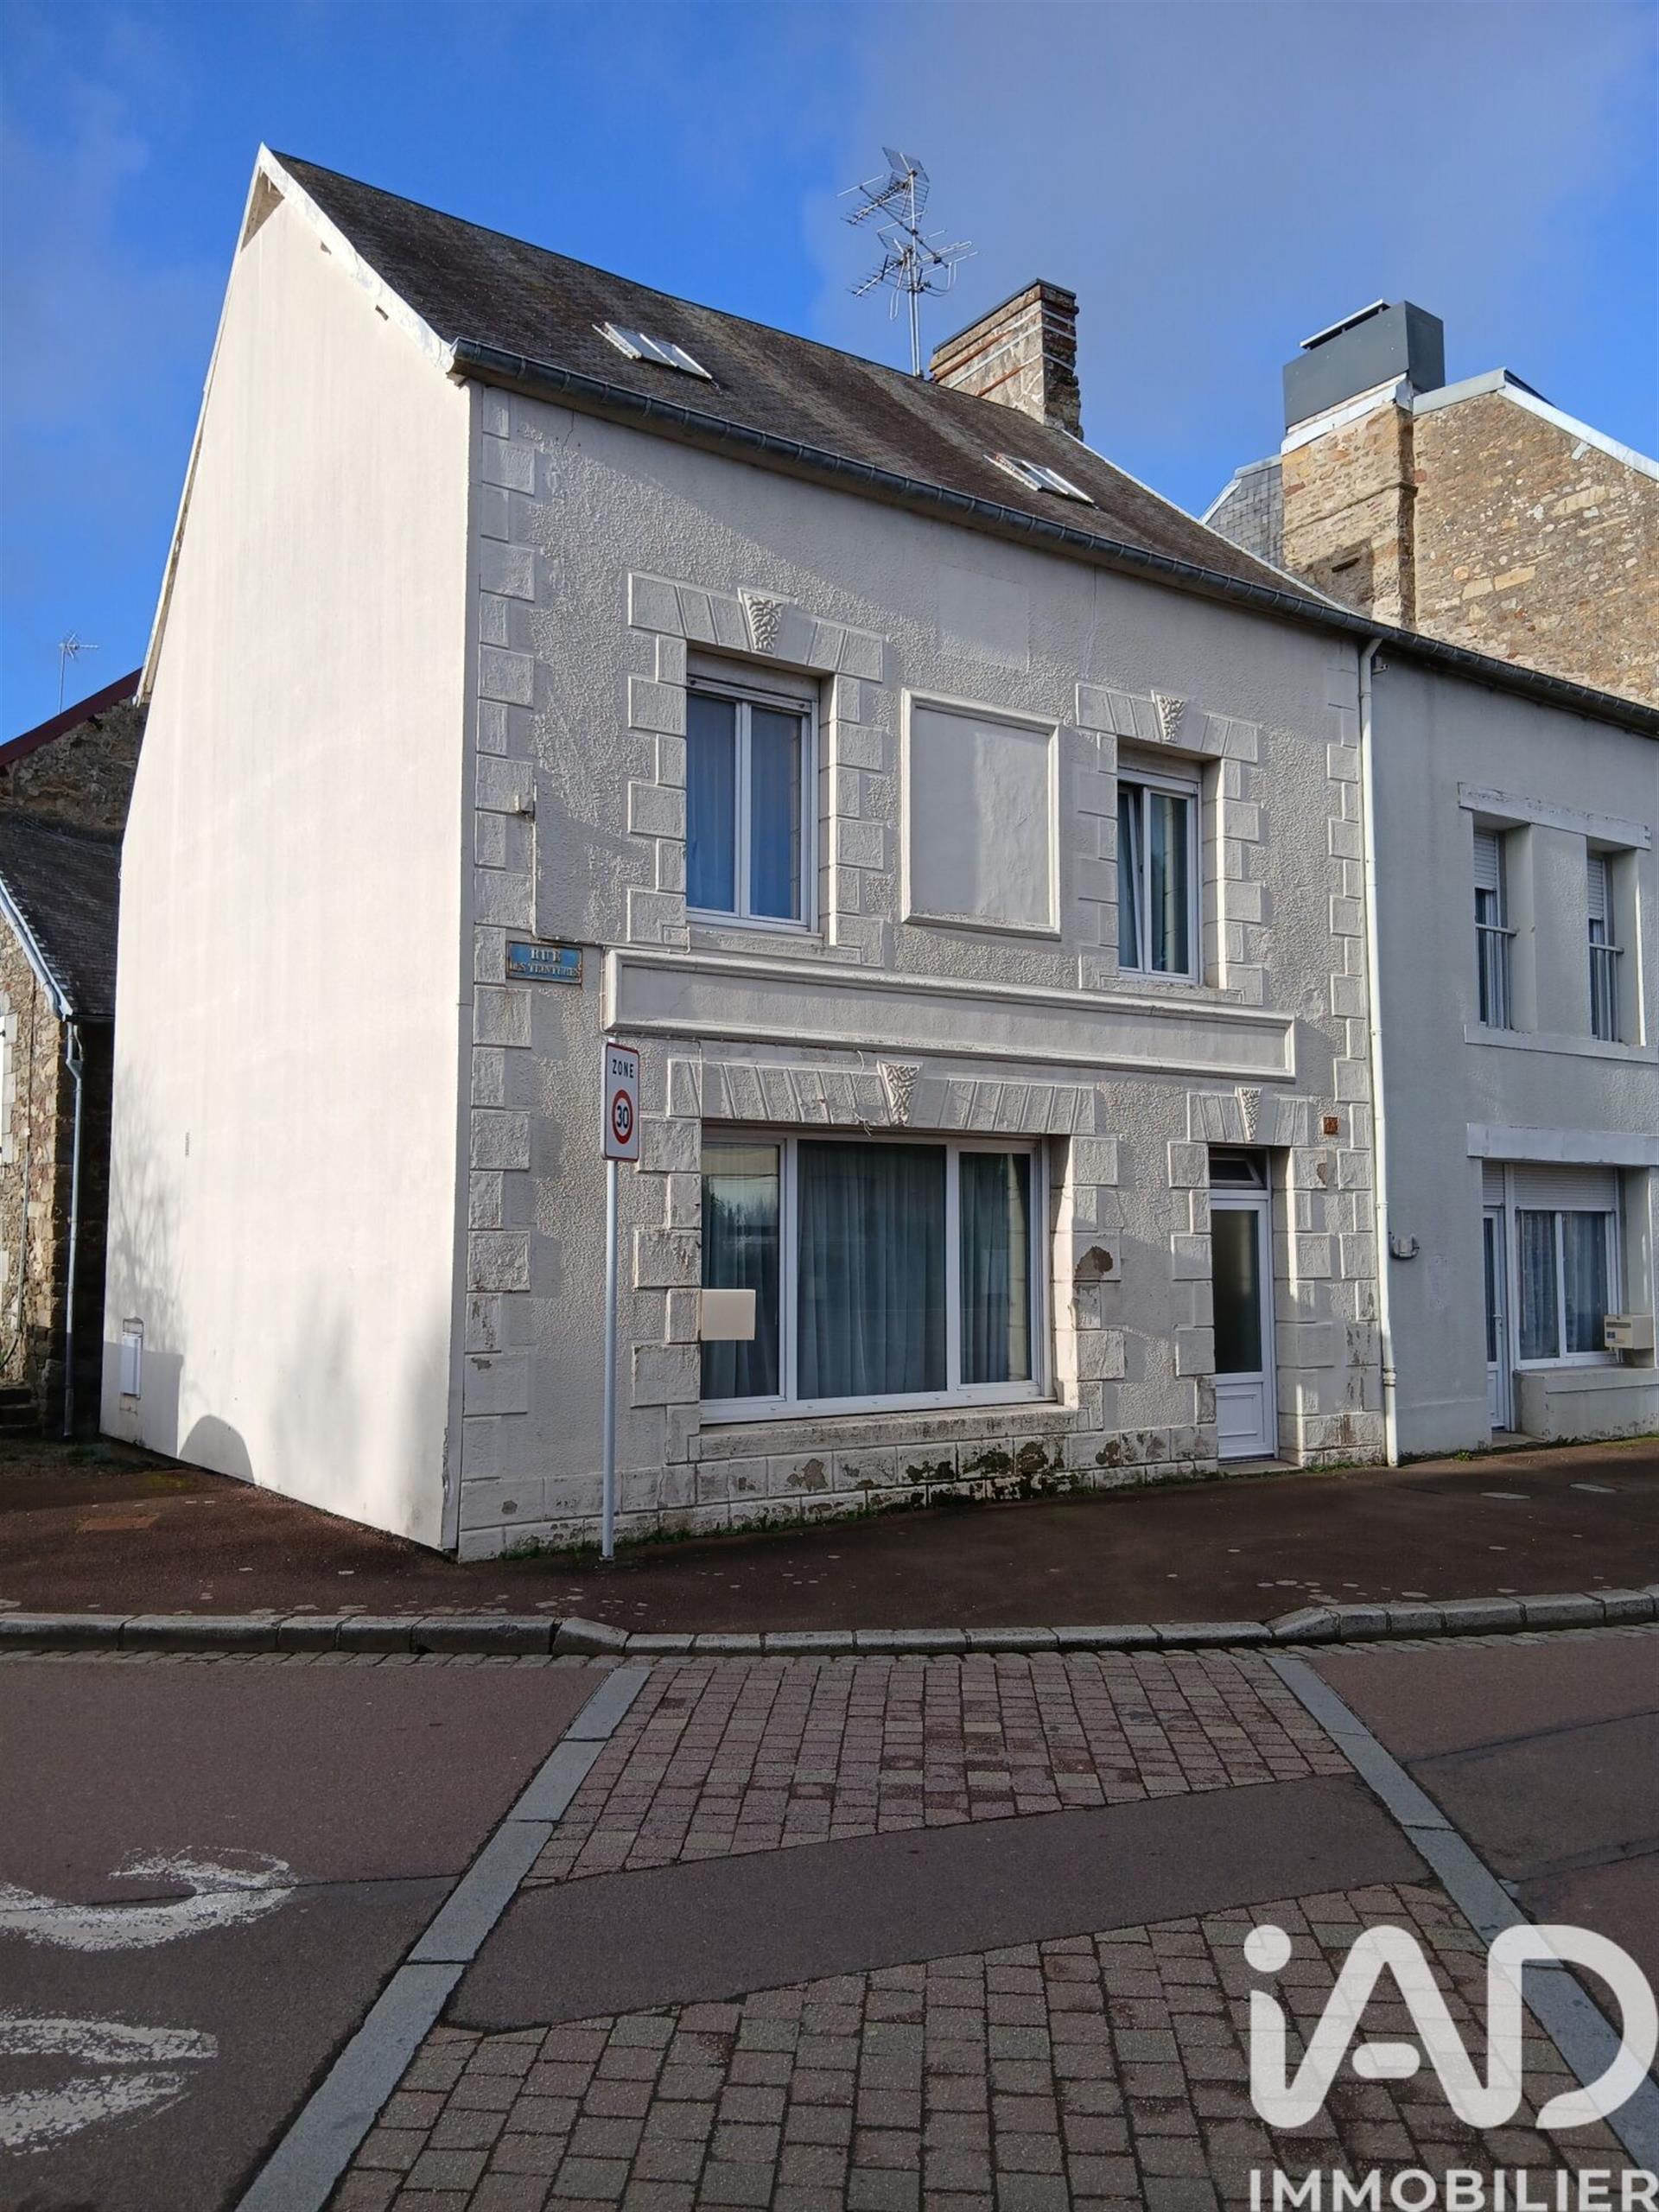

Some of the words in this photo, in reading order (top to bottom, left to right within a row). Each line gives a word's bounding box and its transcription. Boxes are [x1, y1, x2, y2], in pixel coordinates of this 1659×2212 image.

[530, 948, 562, 962] RUE
[612, 1059, 634, 1078] ZONE
[616, 1104, 630, 1128] 30
